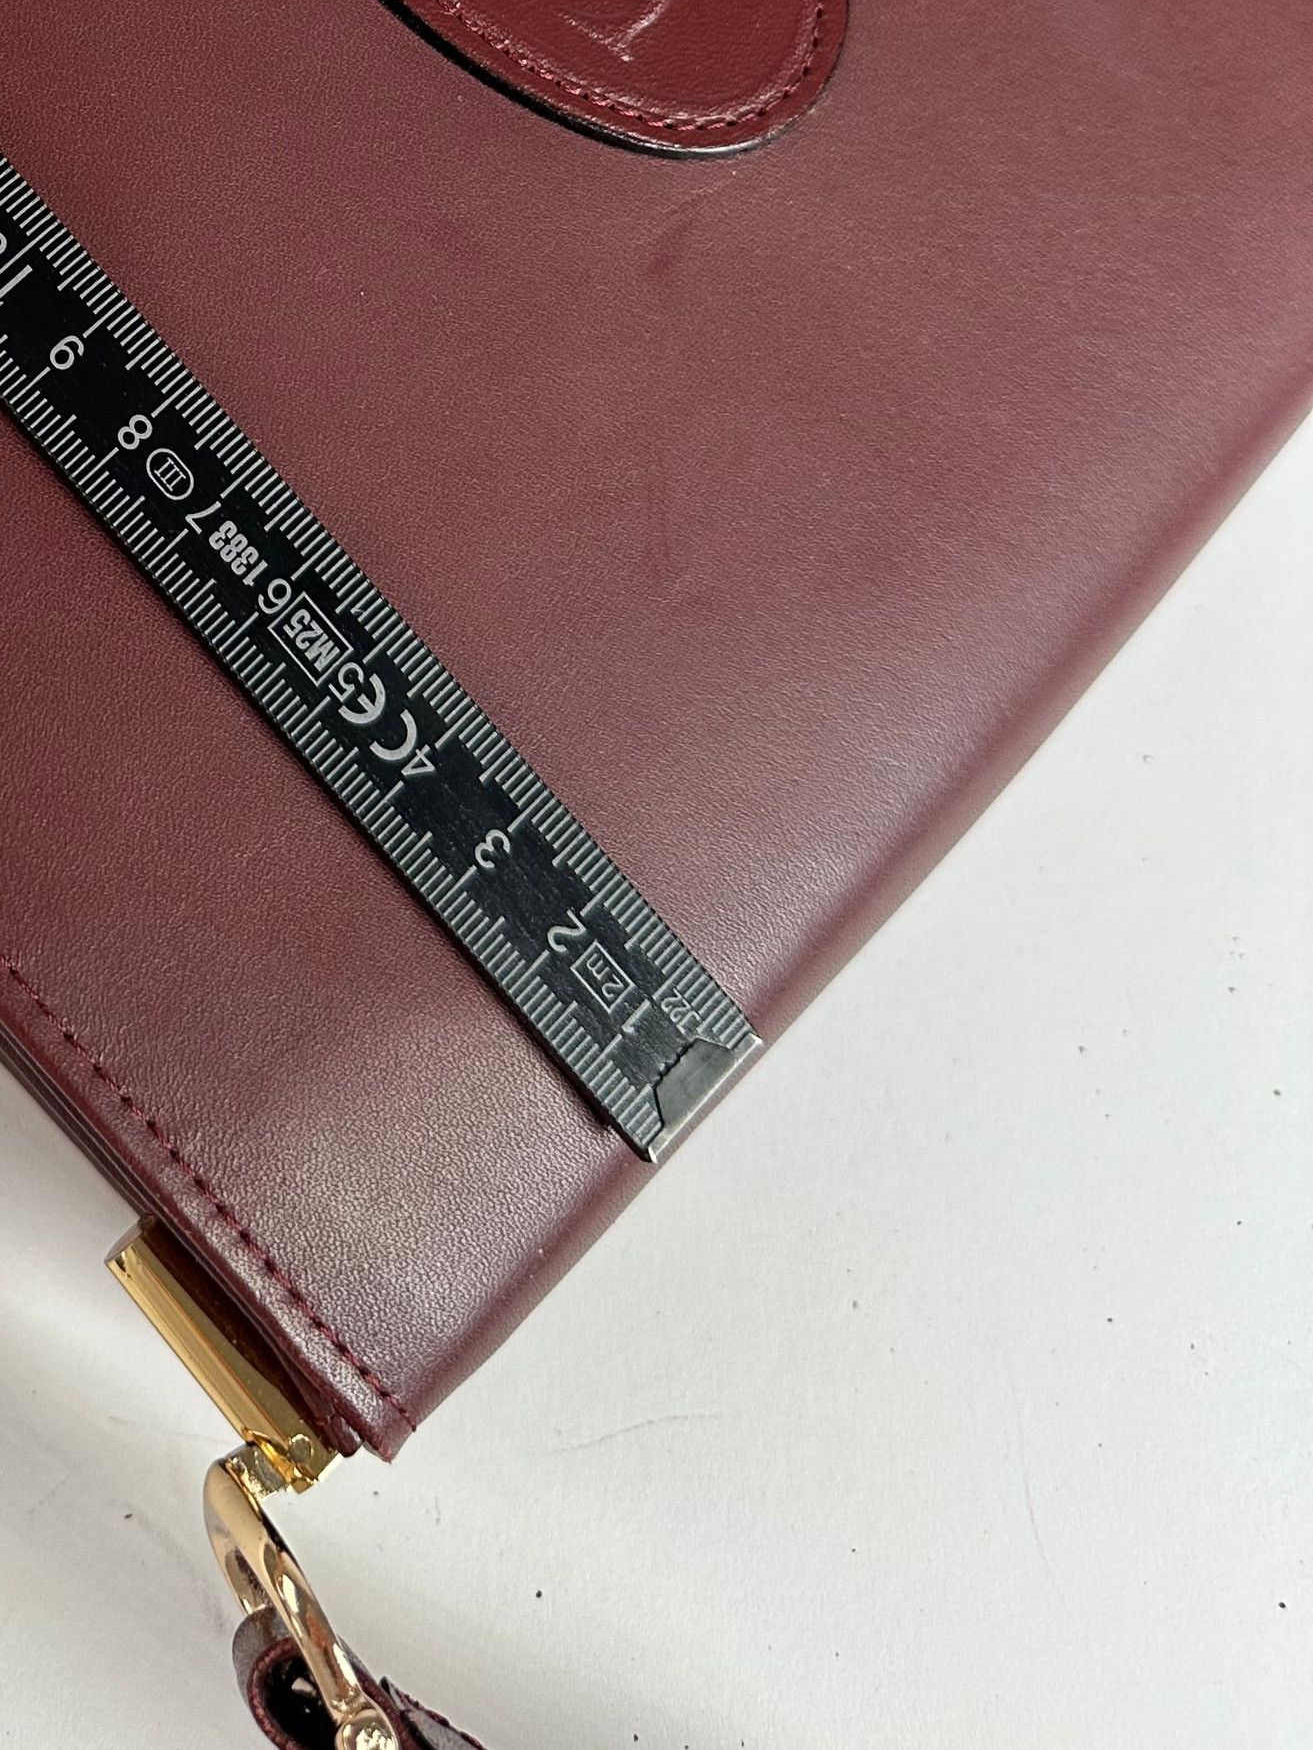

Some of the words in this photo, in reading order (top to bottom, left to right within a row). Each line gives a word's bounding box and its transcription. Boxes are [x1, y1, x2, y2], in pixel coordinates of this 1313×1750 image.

[49, 335, 85, 370] 9
[117, 414, 153, 450] 8
[185, 500, 222, 535] 7
[208, 520, 268, 586] 1383
[258, 578, 292, 614] 6
[283, 609, 341, 672] M25
[328, 662, 364, 702] 5
[338, 673, 418, 761] CE
[401, 744, 436, 776] 4
[475, 828, 512, 869] 3
[547, 907, 587, 952] 2
[621, 999, 650, 1034] 1
